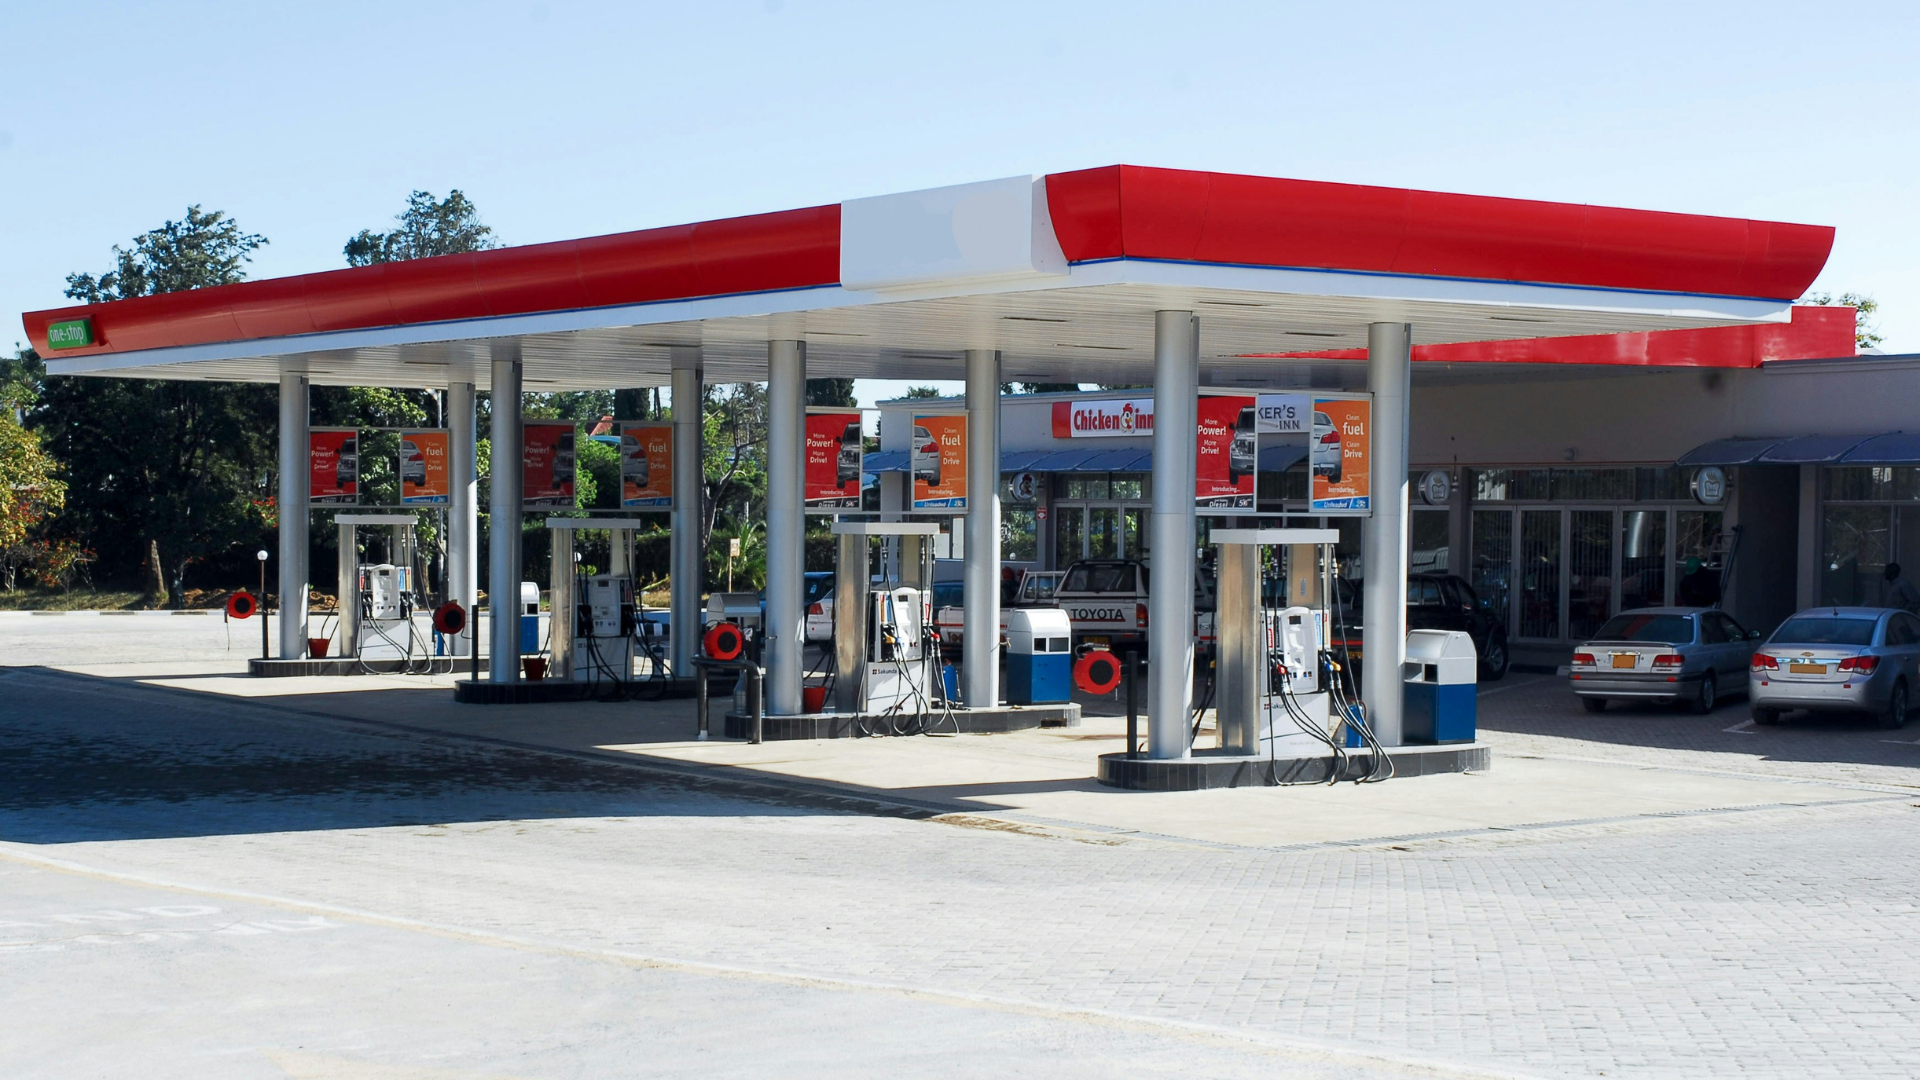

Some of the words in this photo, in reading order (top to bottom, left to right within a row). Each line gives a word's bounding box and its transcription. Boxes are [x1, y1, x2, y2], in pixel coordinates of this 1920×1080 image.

[50, 325, 84, 344] one-stop
[1074, 409, 1120, 430] Chicken
[1135, 408, 1153, 428] inn
[1279, 420, 1300, 430] INN
[1343, 422, 1364, 435] fuel
[1198, 425, 1227, 436] Power!
[806, 438, 834, 448] Power!
[941, 434, 961, 446] fuel
[426, 447, 443, 456] fuel
[648, 443, 667, 453] fuel
[1201, 446, 1220, 454] Drive!
[1344, 449, 1362, 458] Drive
[810, 456, 827, 464] Drive!
[943, 457, 960, 465] Drive
[1071, 608, 1124, 619] TOYOTA
